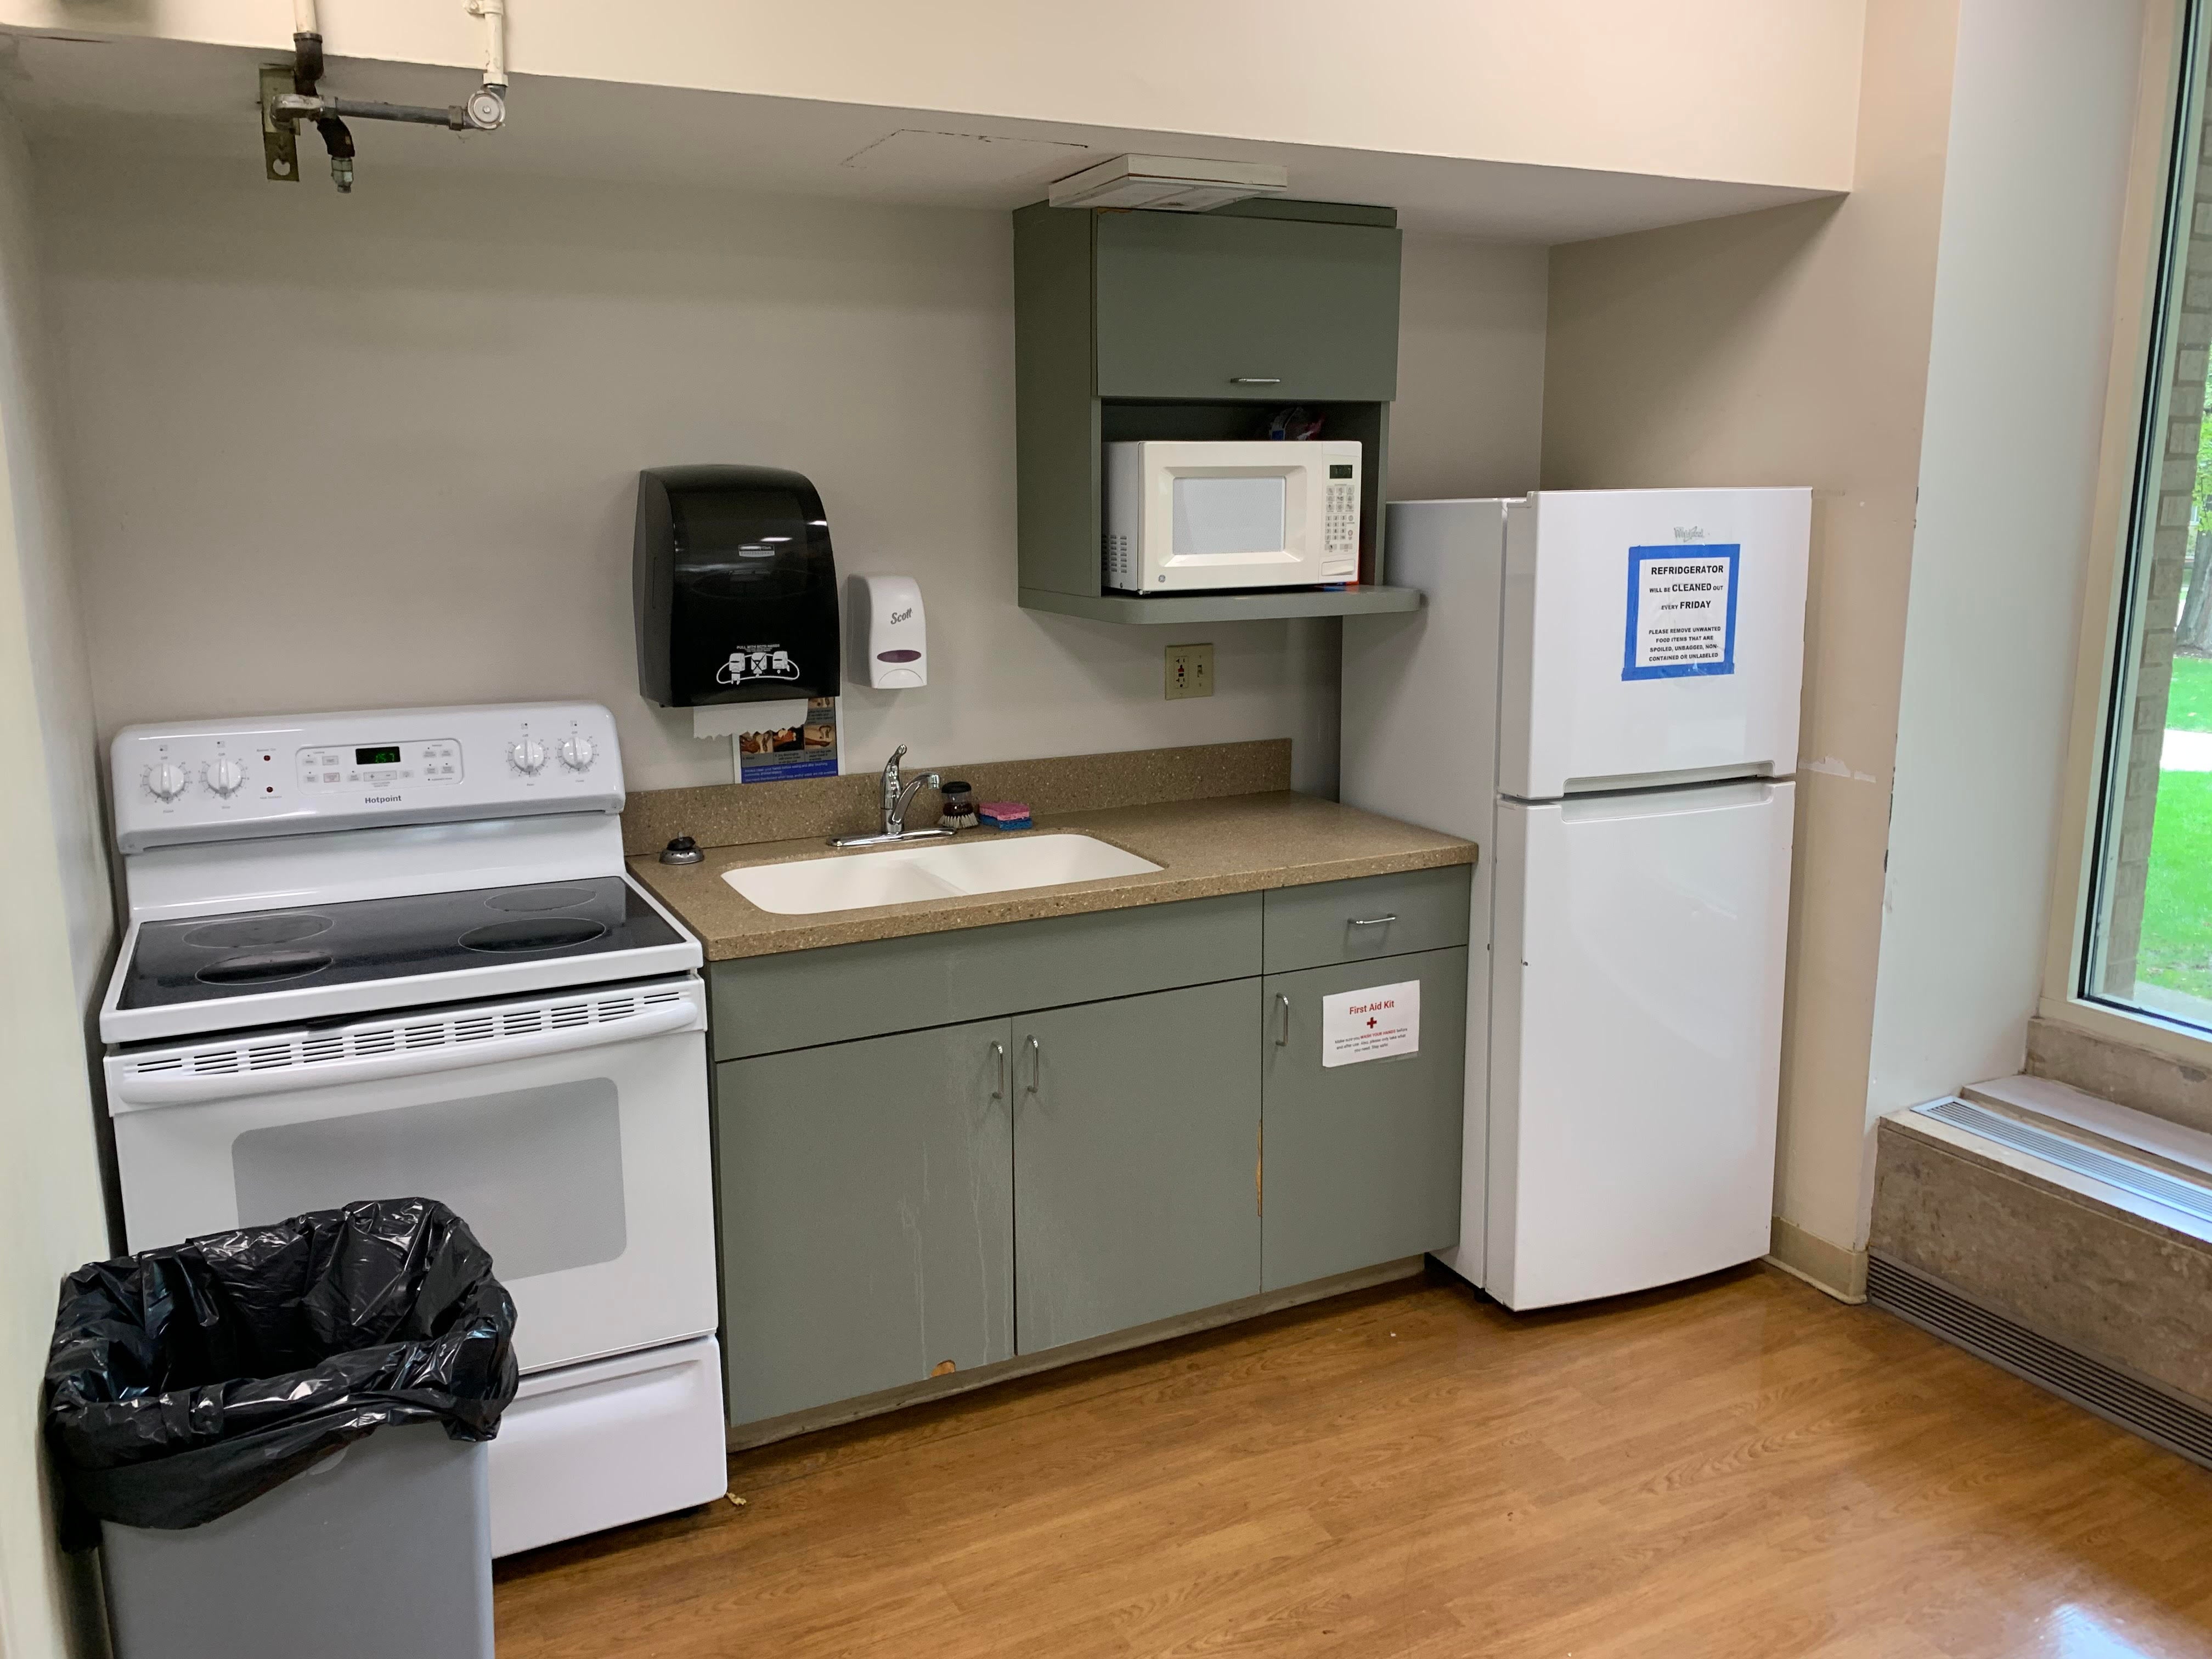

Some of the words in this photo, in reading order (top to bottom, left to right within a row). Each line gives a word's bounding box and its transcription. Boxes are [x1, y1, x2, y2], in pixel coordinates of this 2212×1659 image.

[1651, 565, 1724, 575] REFRIDGERATOR
[1672, 583, 1712, 592] CLEANED
[1680, 600, 1711, 609] FRIDAY
[890, 607, 912, 625] Scott
[365, 795, 402, 804] Hotpoint
[1350, 1005, 1367, 1015] First
[1369, 1001, 1381, 1012] Aid
[1384, 1000, 1395, 1009] Kit
